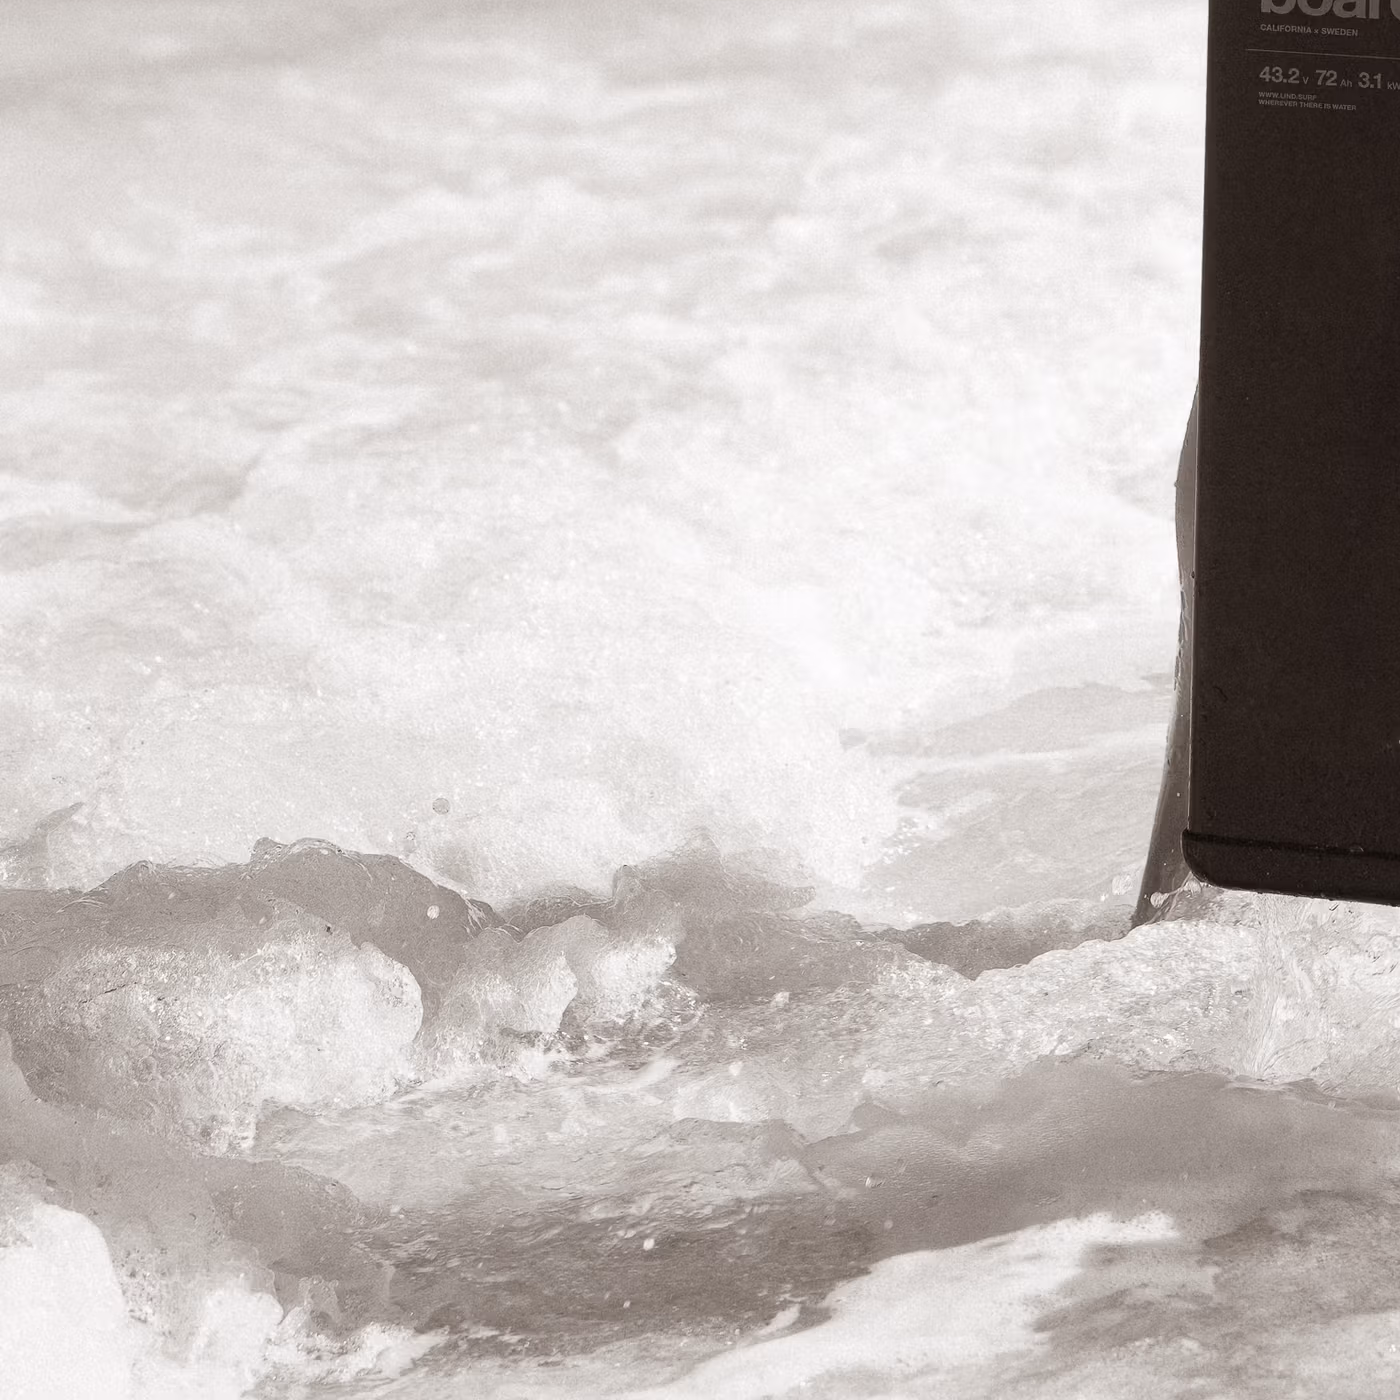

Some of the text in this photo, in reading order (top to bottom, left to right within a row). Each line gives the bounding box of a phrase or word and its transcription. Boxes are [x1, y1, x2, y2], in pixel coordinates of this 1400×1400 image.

[1260, 23, 1312, 34] CALIFORNIA
[1321, 27, 1359, 37] SWEDEN
[1259, 66, 1300, 84] 43.2
[1315, 69, 1338, 86] 72
[1340, 79, 1353, 88] Ah
[1358, 72, 1382, 89] 3.1
[1258, 99, 1298, 108] WHEREVER
[1299, 101, 1323, 109] THERE
[1332, 103, 1357, 111] WATER
